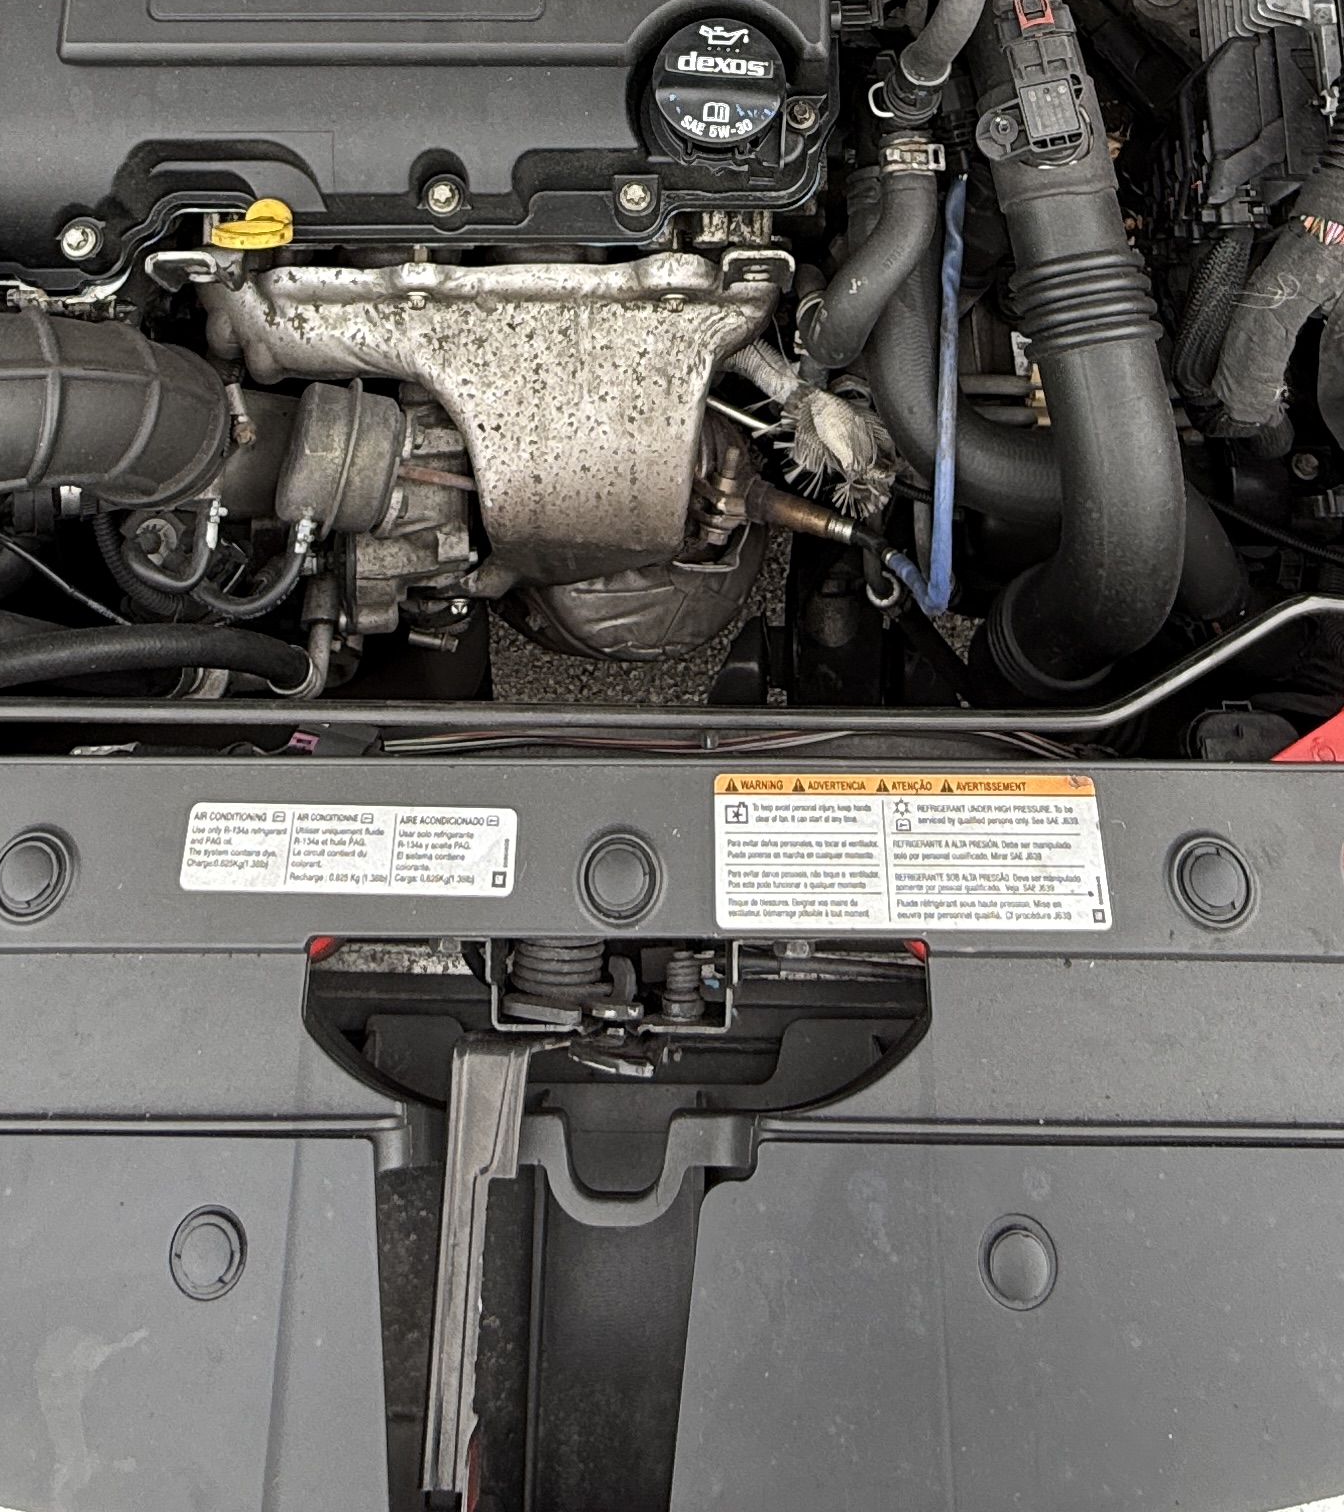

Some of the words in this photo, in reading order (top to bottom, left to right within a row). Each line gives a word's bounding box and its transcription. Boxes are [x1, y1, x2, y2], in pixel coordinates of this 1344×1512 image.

[678, 51, 765, 76] dexos
[681, 115, 706, 136] SAE
[709, 119, 752, 138] 5W-30
[740, 780, 783, 790] WARNING
[808, 781, 866, 790] ADVERTENCIA
[891, 779, 933, 794] ATENÇÃO
[956, 782, 1026, 791] AVERTISSEMENT
[194, 812, 207, 820] AIR
[210, 812, 267, 822] CONDITIONING
[297, 813, 308, 821] AIR
[400, 816, 417, 825] AIRE
[420, 816, 484, 826] ACONDICIONADO
[208, 827, 221, 835] only
